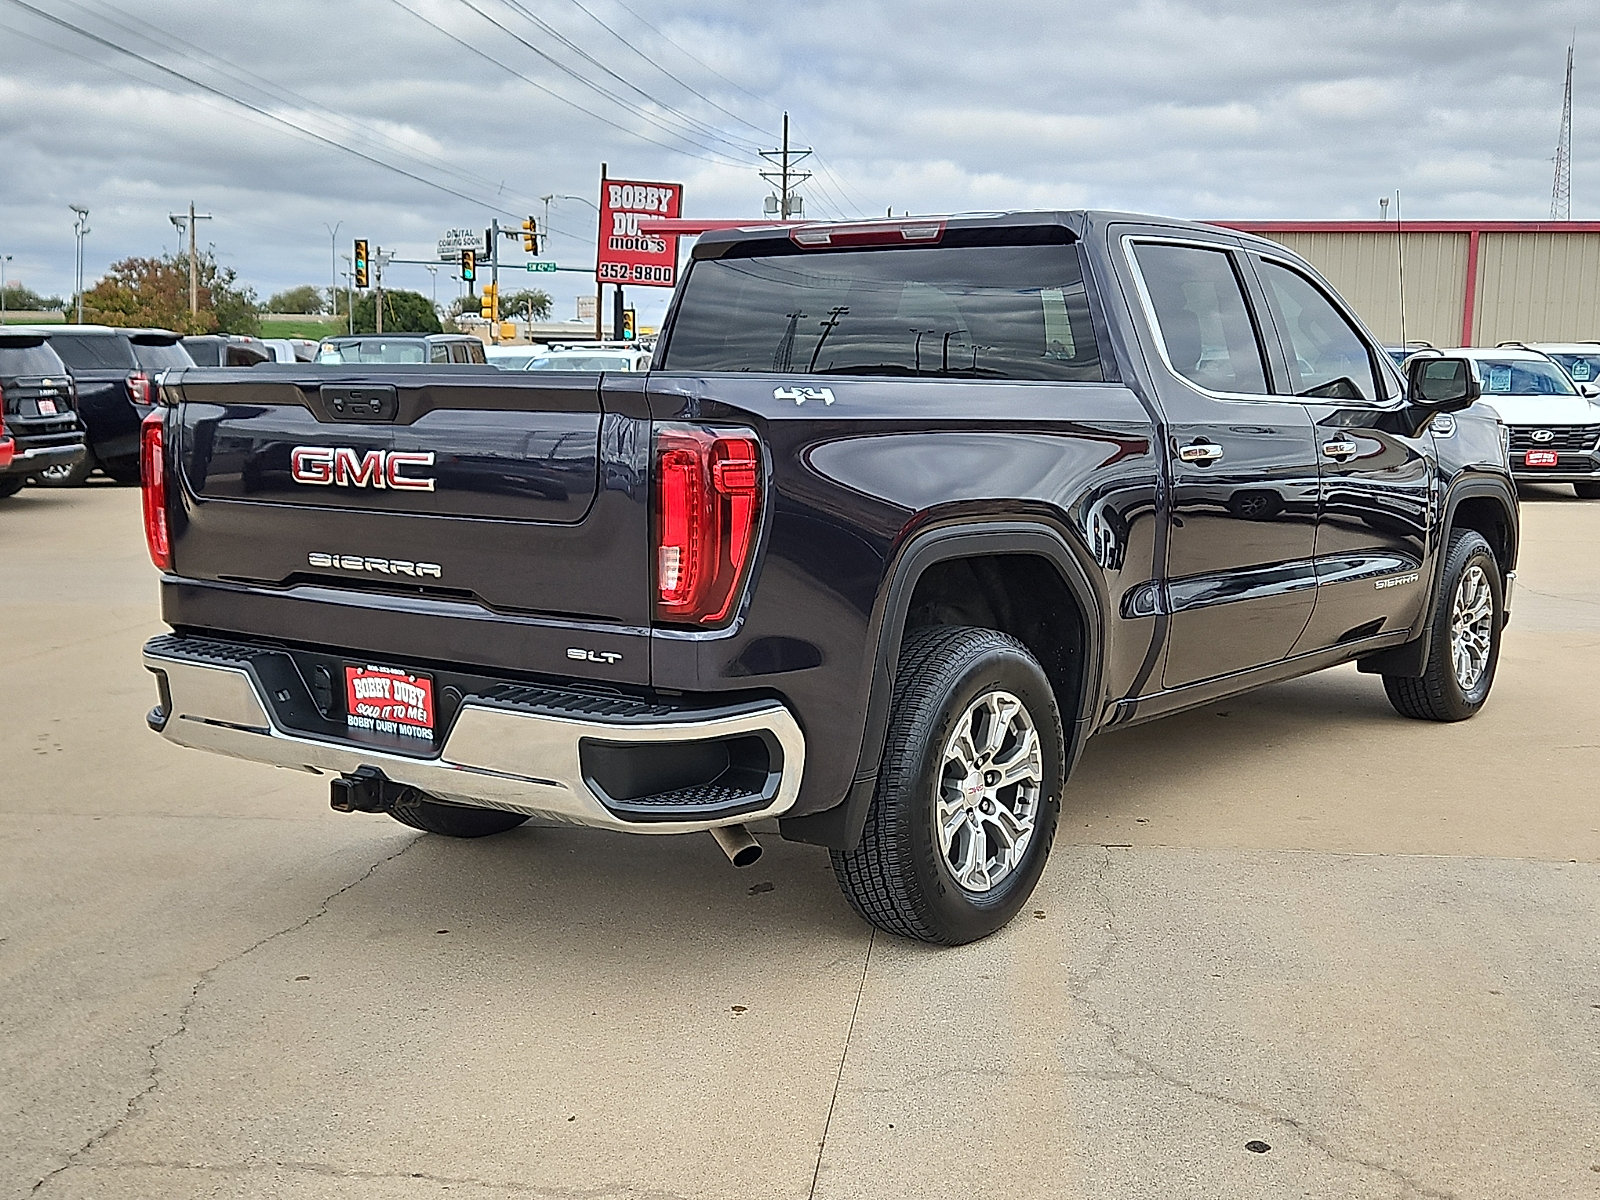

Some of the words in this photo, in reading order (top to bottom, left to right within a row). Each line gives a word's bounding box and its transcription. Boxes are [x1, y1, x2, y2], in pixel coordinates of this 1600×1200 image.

[608, 185, 673, 212] BOBBY
[599, 262, 673, 282] 352-9800
[291, 446, 436, 492] GMC
[308, 552, 442, 578] SIERRA
[1375, 573, 1419, 590] SIERRA
[567, 648, 622, 664] SLT
[352, 677, 391, 699] BOBBY
[392, 679, 426, 709] DUBY
[355, 703, 380, 719] SOLD
[381, 705, 393, 720] IT
[393, 705, 406, 719] TO
[407, 705, 428, 724] ME!
[347, 714, 374, 730] BOBBY
[375, 719, 398, 734] DUBY
[398, 723, 434, 740] MOTORS
